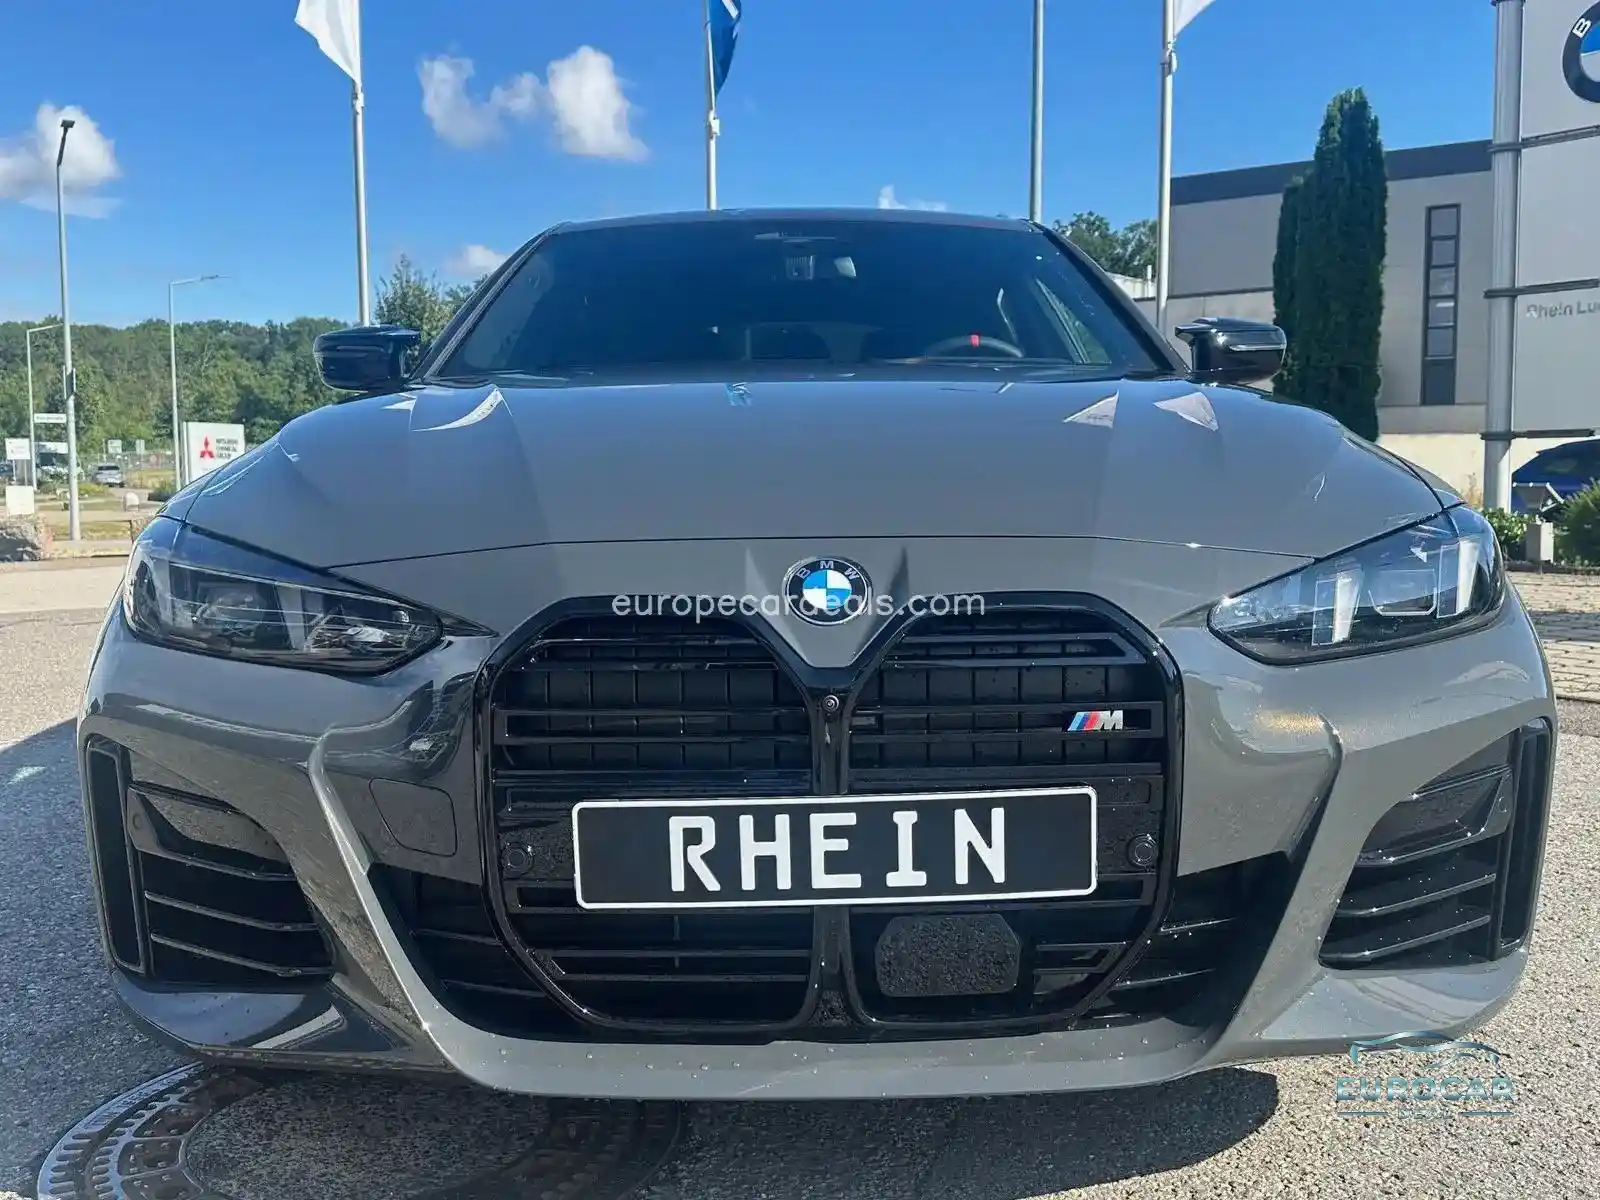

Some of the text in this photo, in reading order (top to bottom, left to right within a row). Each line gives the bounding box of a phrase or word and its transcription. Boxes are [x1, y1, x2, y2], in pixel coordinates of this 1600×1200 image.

[1526, 302, 1573, 318] Rhein
[796, 560, 859, 580] BMW
[668, 807, 1005, 891] RHEIN
